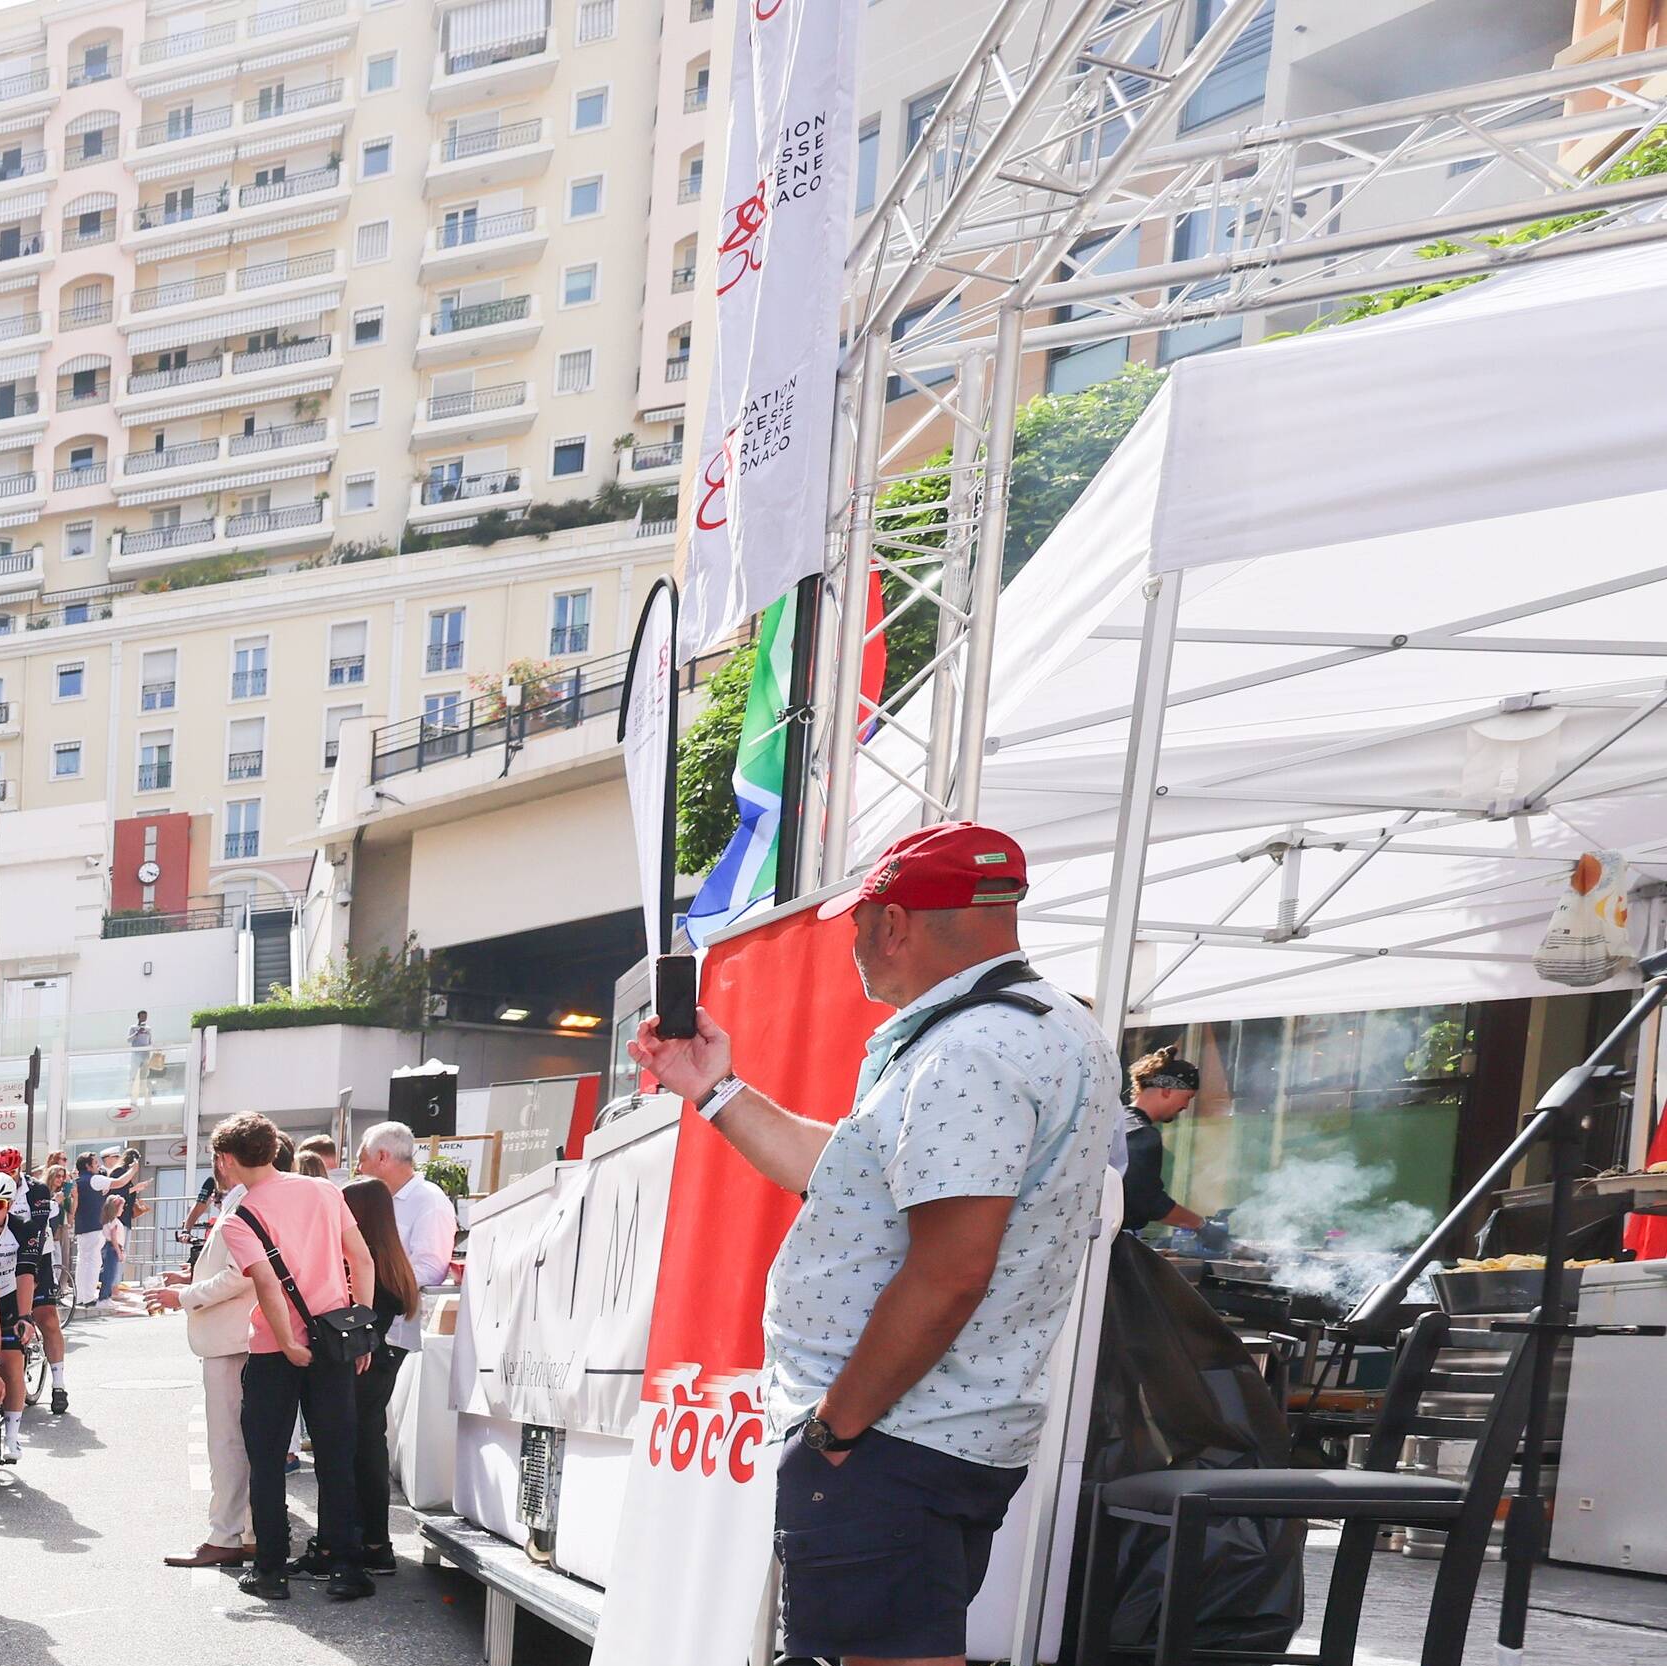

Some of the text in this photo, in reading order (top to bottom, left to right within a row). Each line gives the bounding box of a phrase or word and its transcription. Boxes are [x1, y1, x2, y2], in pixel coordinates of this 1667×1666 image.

[780, 111, 826, 142] ION
[774, 176, 822, 208] ACO
[649, 1407, 763, 1484] COCC
